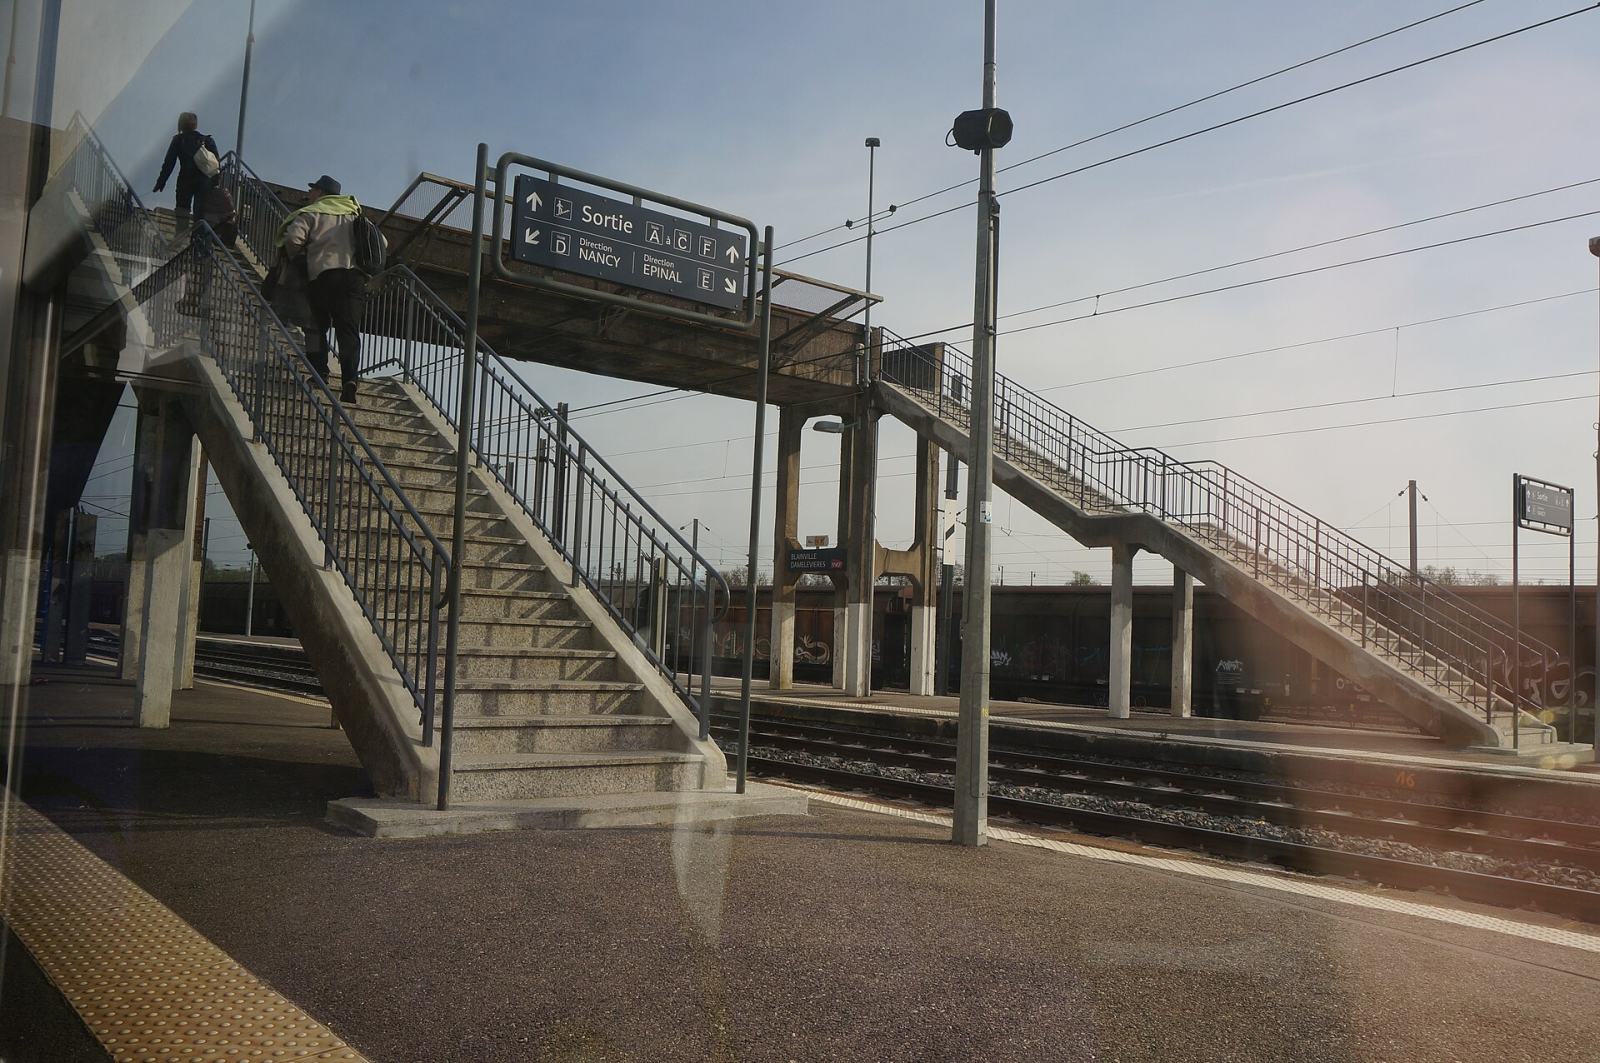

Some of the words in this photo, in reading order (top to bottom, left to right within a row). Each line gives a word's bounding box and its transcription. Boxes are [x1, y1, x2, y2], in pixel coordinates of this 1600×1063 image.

[582, 205, 633, 234] Sortie
[649, 230, 660, 243] A
[665, 236, 671, 245] à
[677, 236, 687, 250] C
[703, 243, 711, 256] F
[555, 239, 566, 254] D
[579, 237, 613, 253] Direction
[579, 247, 621, 268] NANCY
[643, 253, 675, 268] Direction
[643, 263, 682, 284] EPINAL
[702, 275, 710, 288] E
[791, 552, 817, 560] BLAINVILLE
